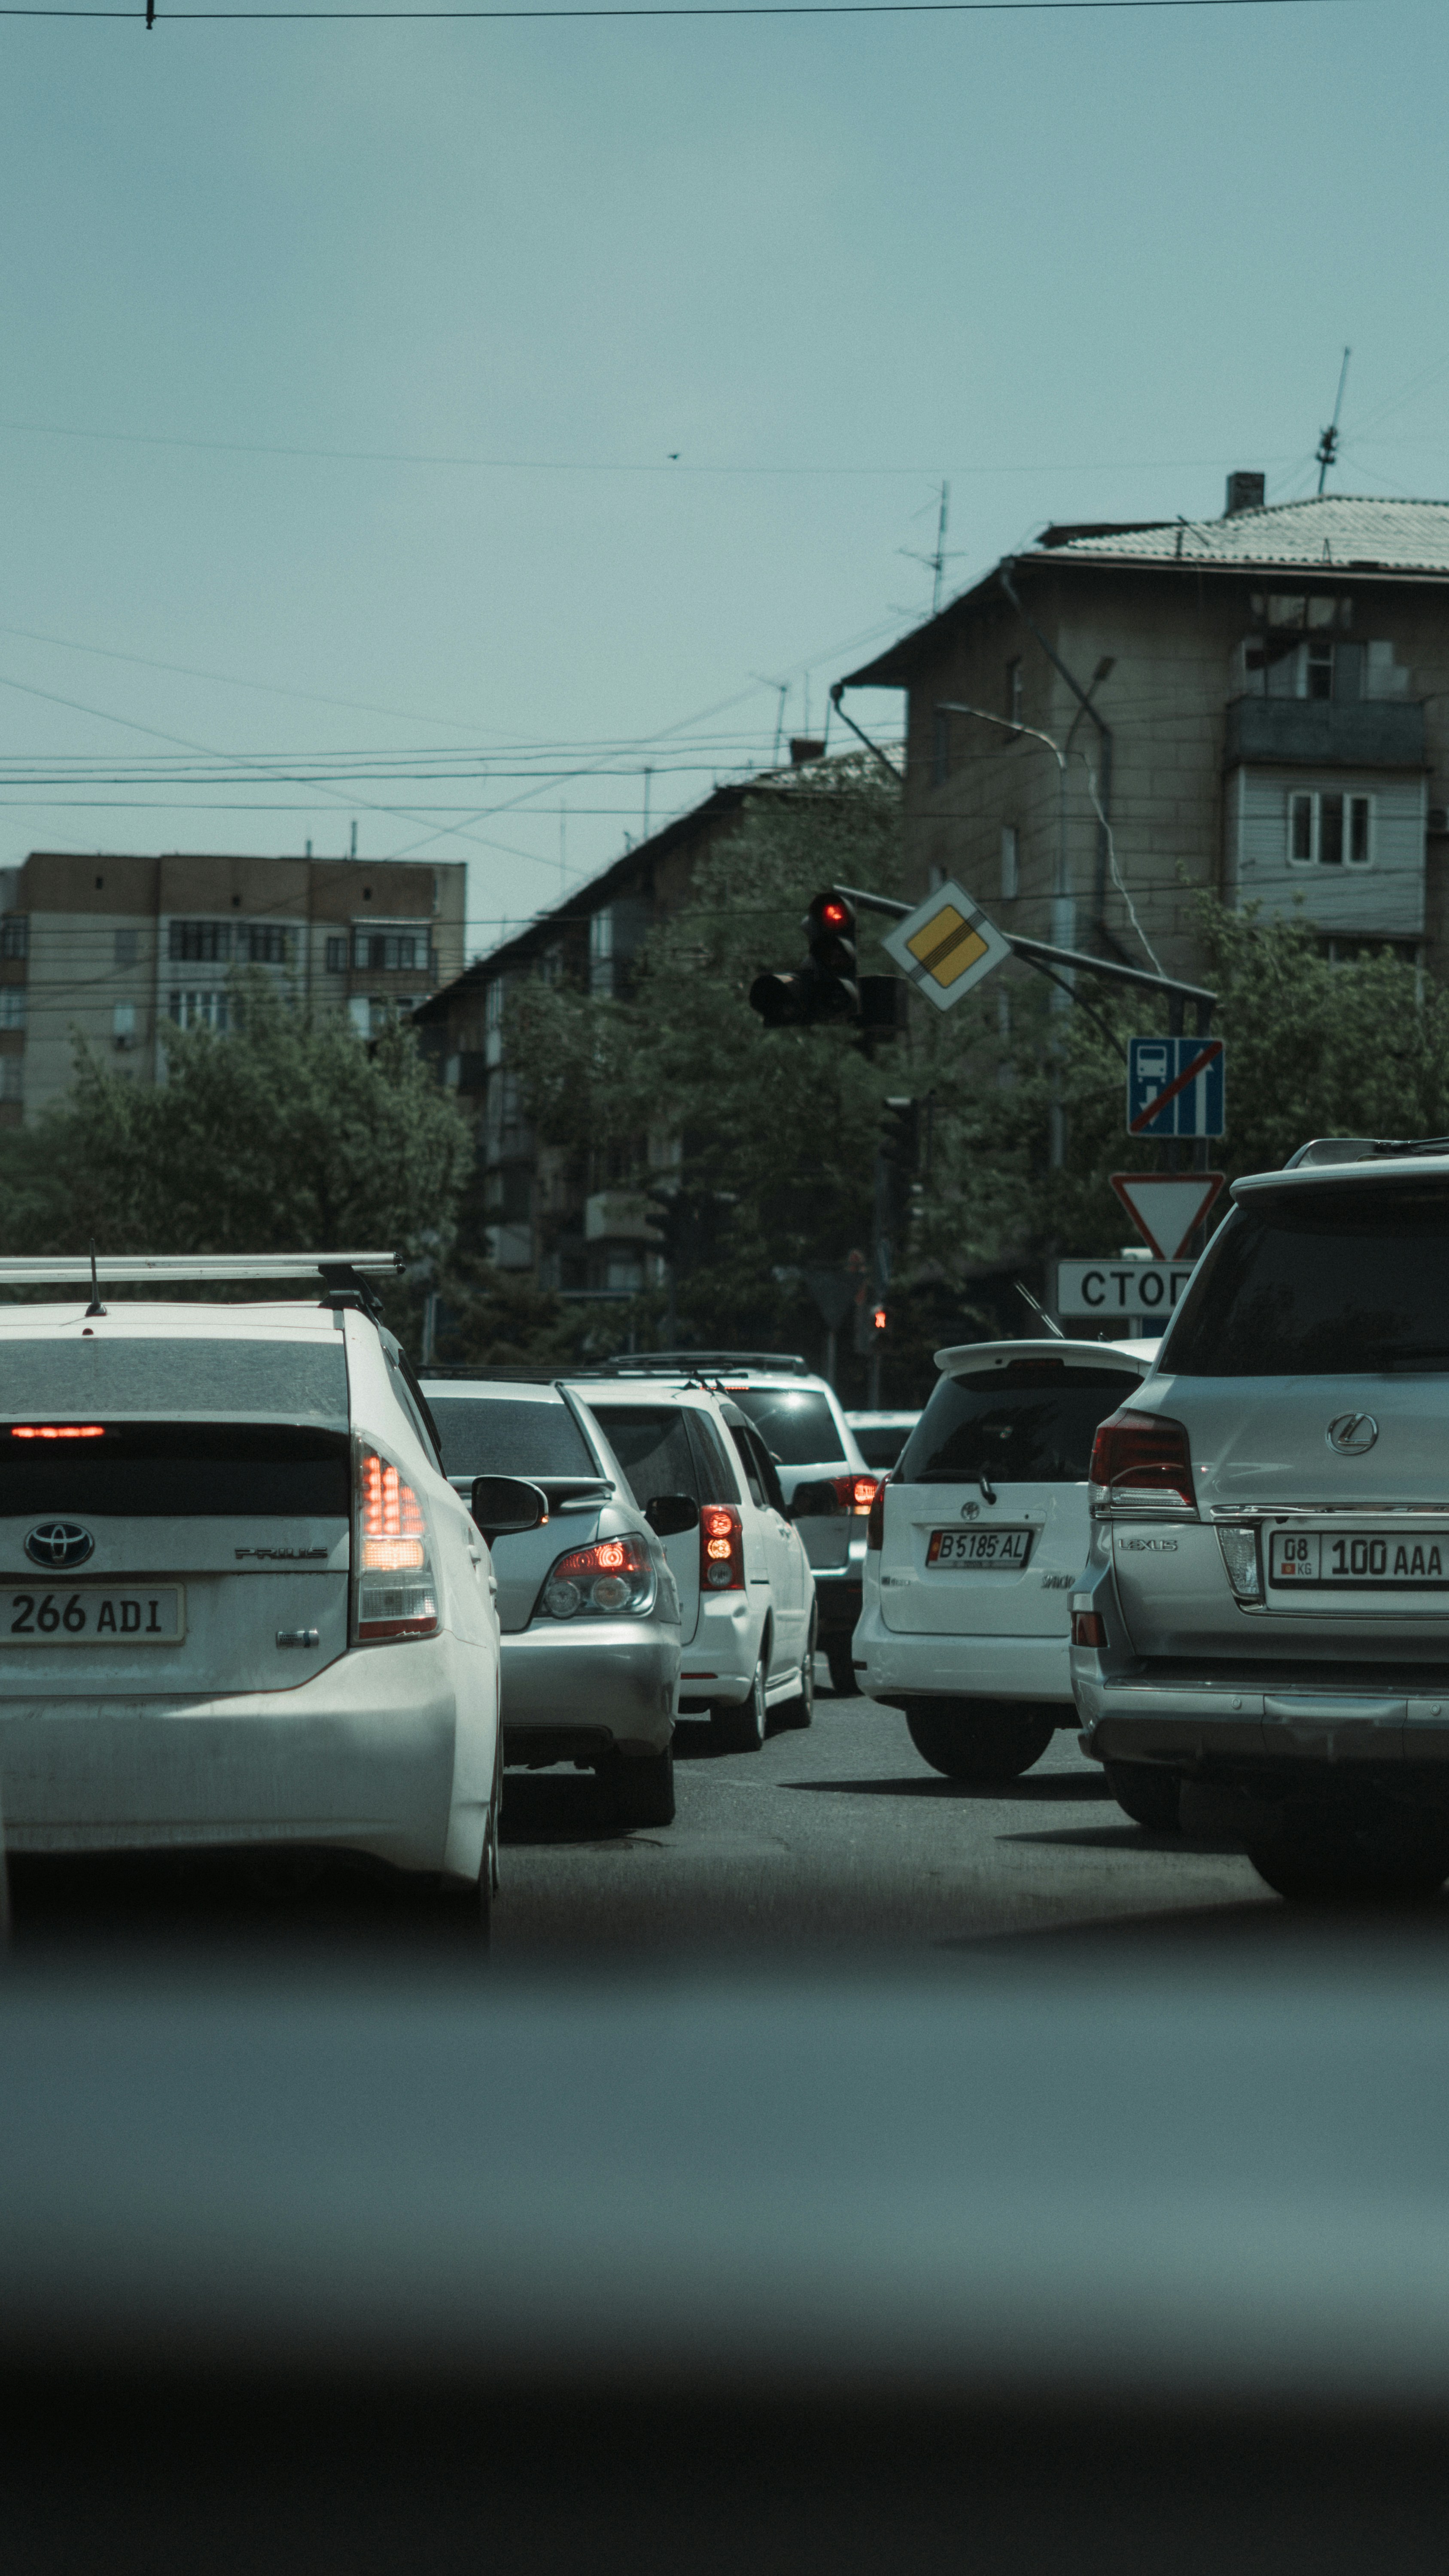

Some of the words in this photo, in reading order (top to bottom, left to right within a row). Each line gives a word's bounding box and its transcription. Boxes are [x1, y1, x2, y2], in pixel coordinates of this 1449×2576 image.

[235, 1548, 328, 1559] PRIUS
[999, 1535, 1023, 1558] AL
[1118, 1539, 1178, 1551] LEXUS
[1285, 1538, 1308, 1561] 08
[1332, 1539, 1387, 1575] 100
[1393, 1545, 1442, 1575] AAA
[1297, 1563, 1312, 1575] KG
[11, 1594, 86, 1633] 266
[97, 1600, 162, 1632] ADI
